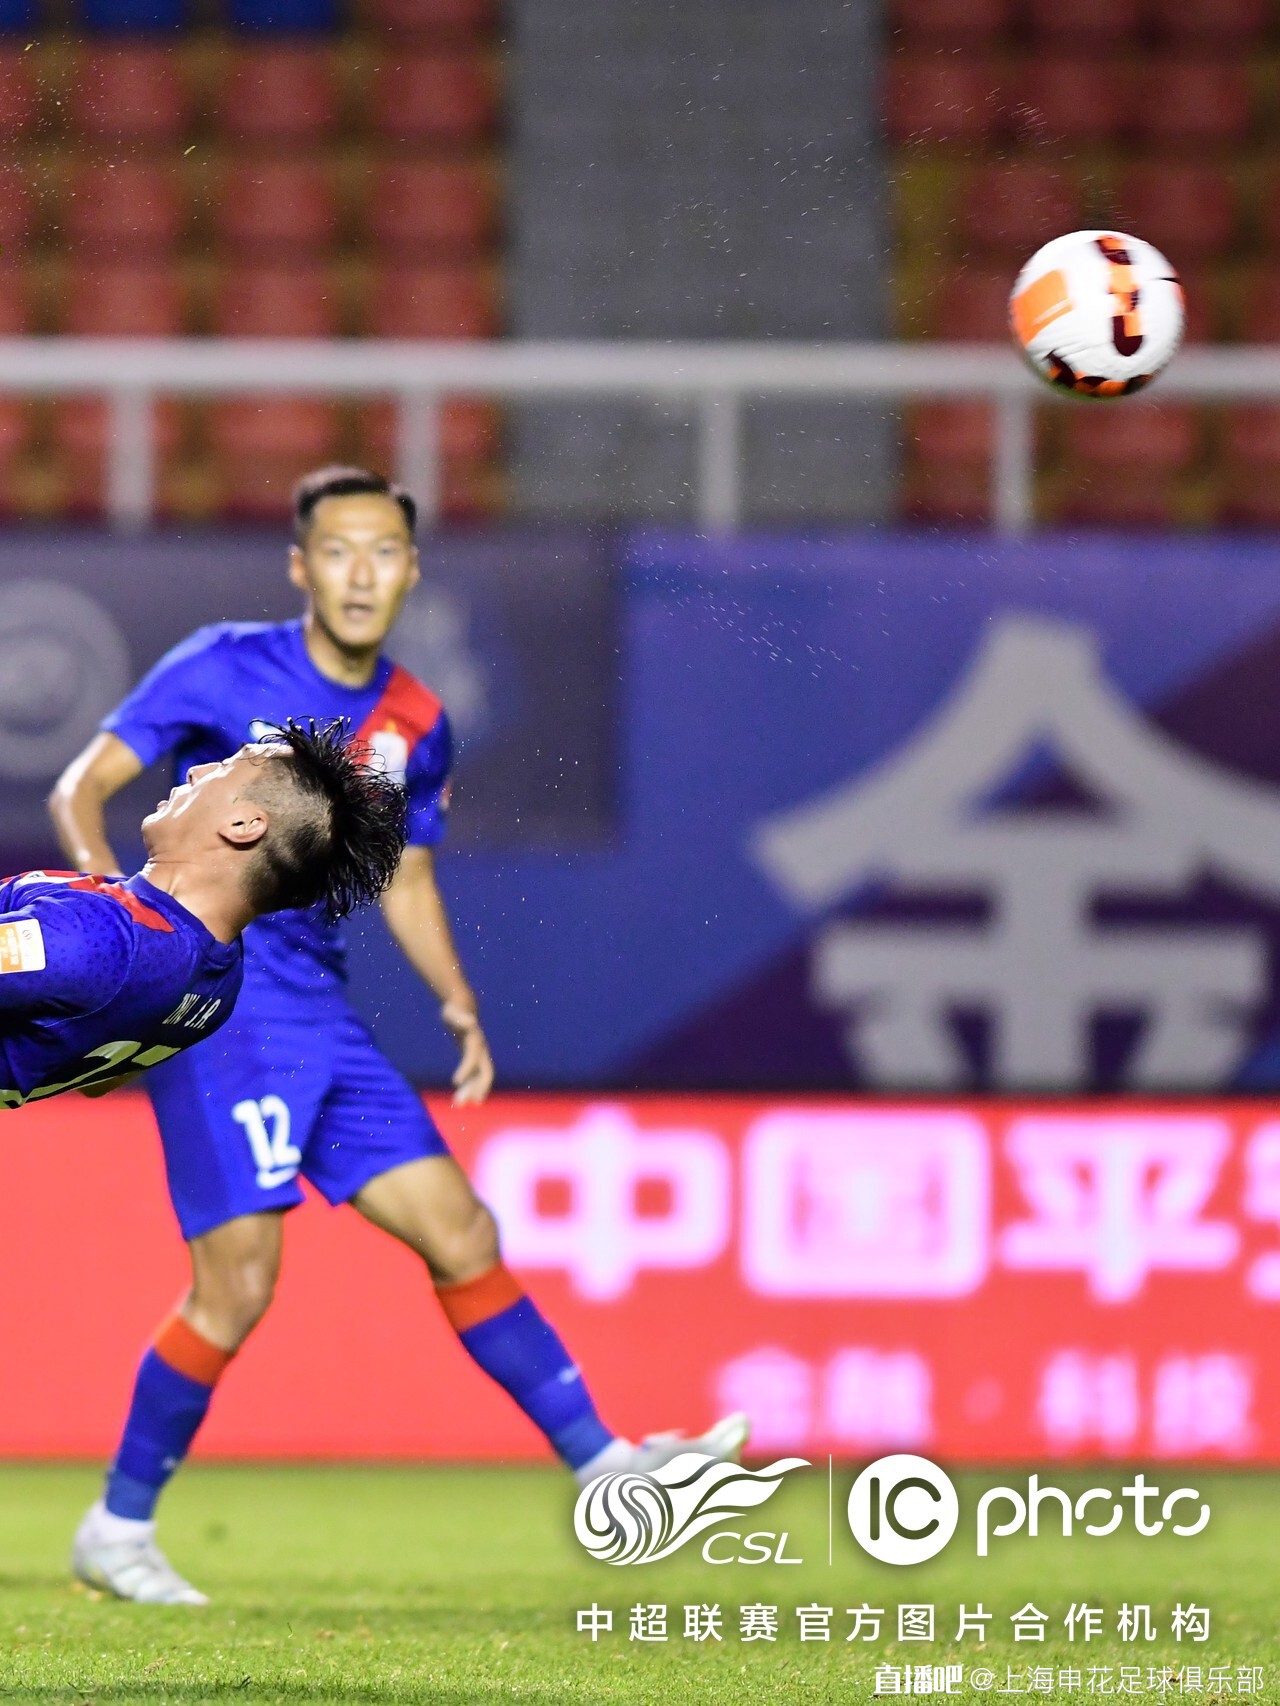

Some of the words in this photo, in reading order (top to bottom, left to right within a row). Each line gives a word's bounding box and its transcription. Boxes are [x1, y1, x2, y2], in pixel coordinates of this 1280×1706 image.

[231, 1094, 302, 1170] 12
[475, 1103, 1280, 1306] 中国平
